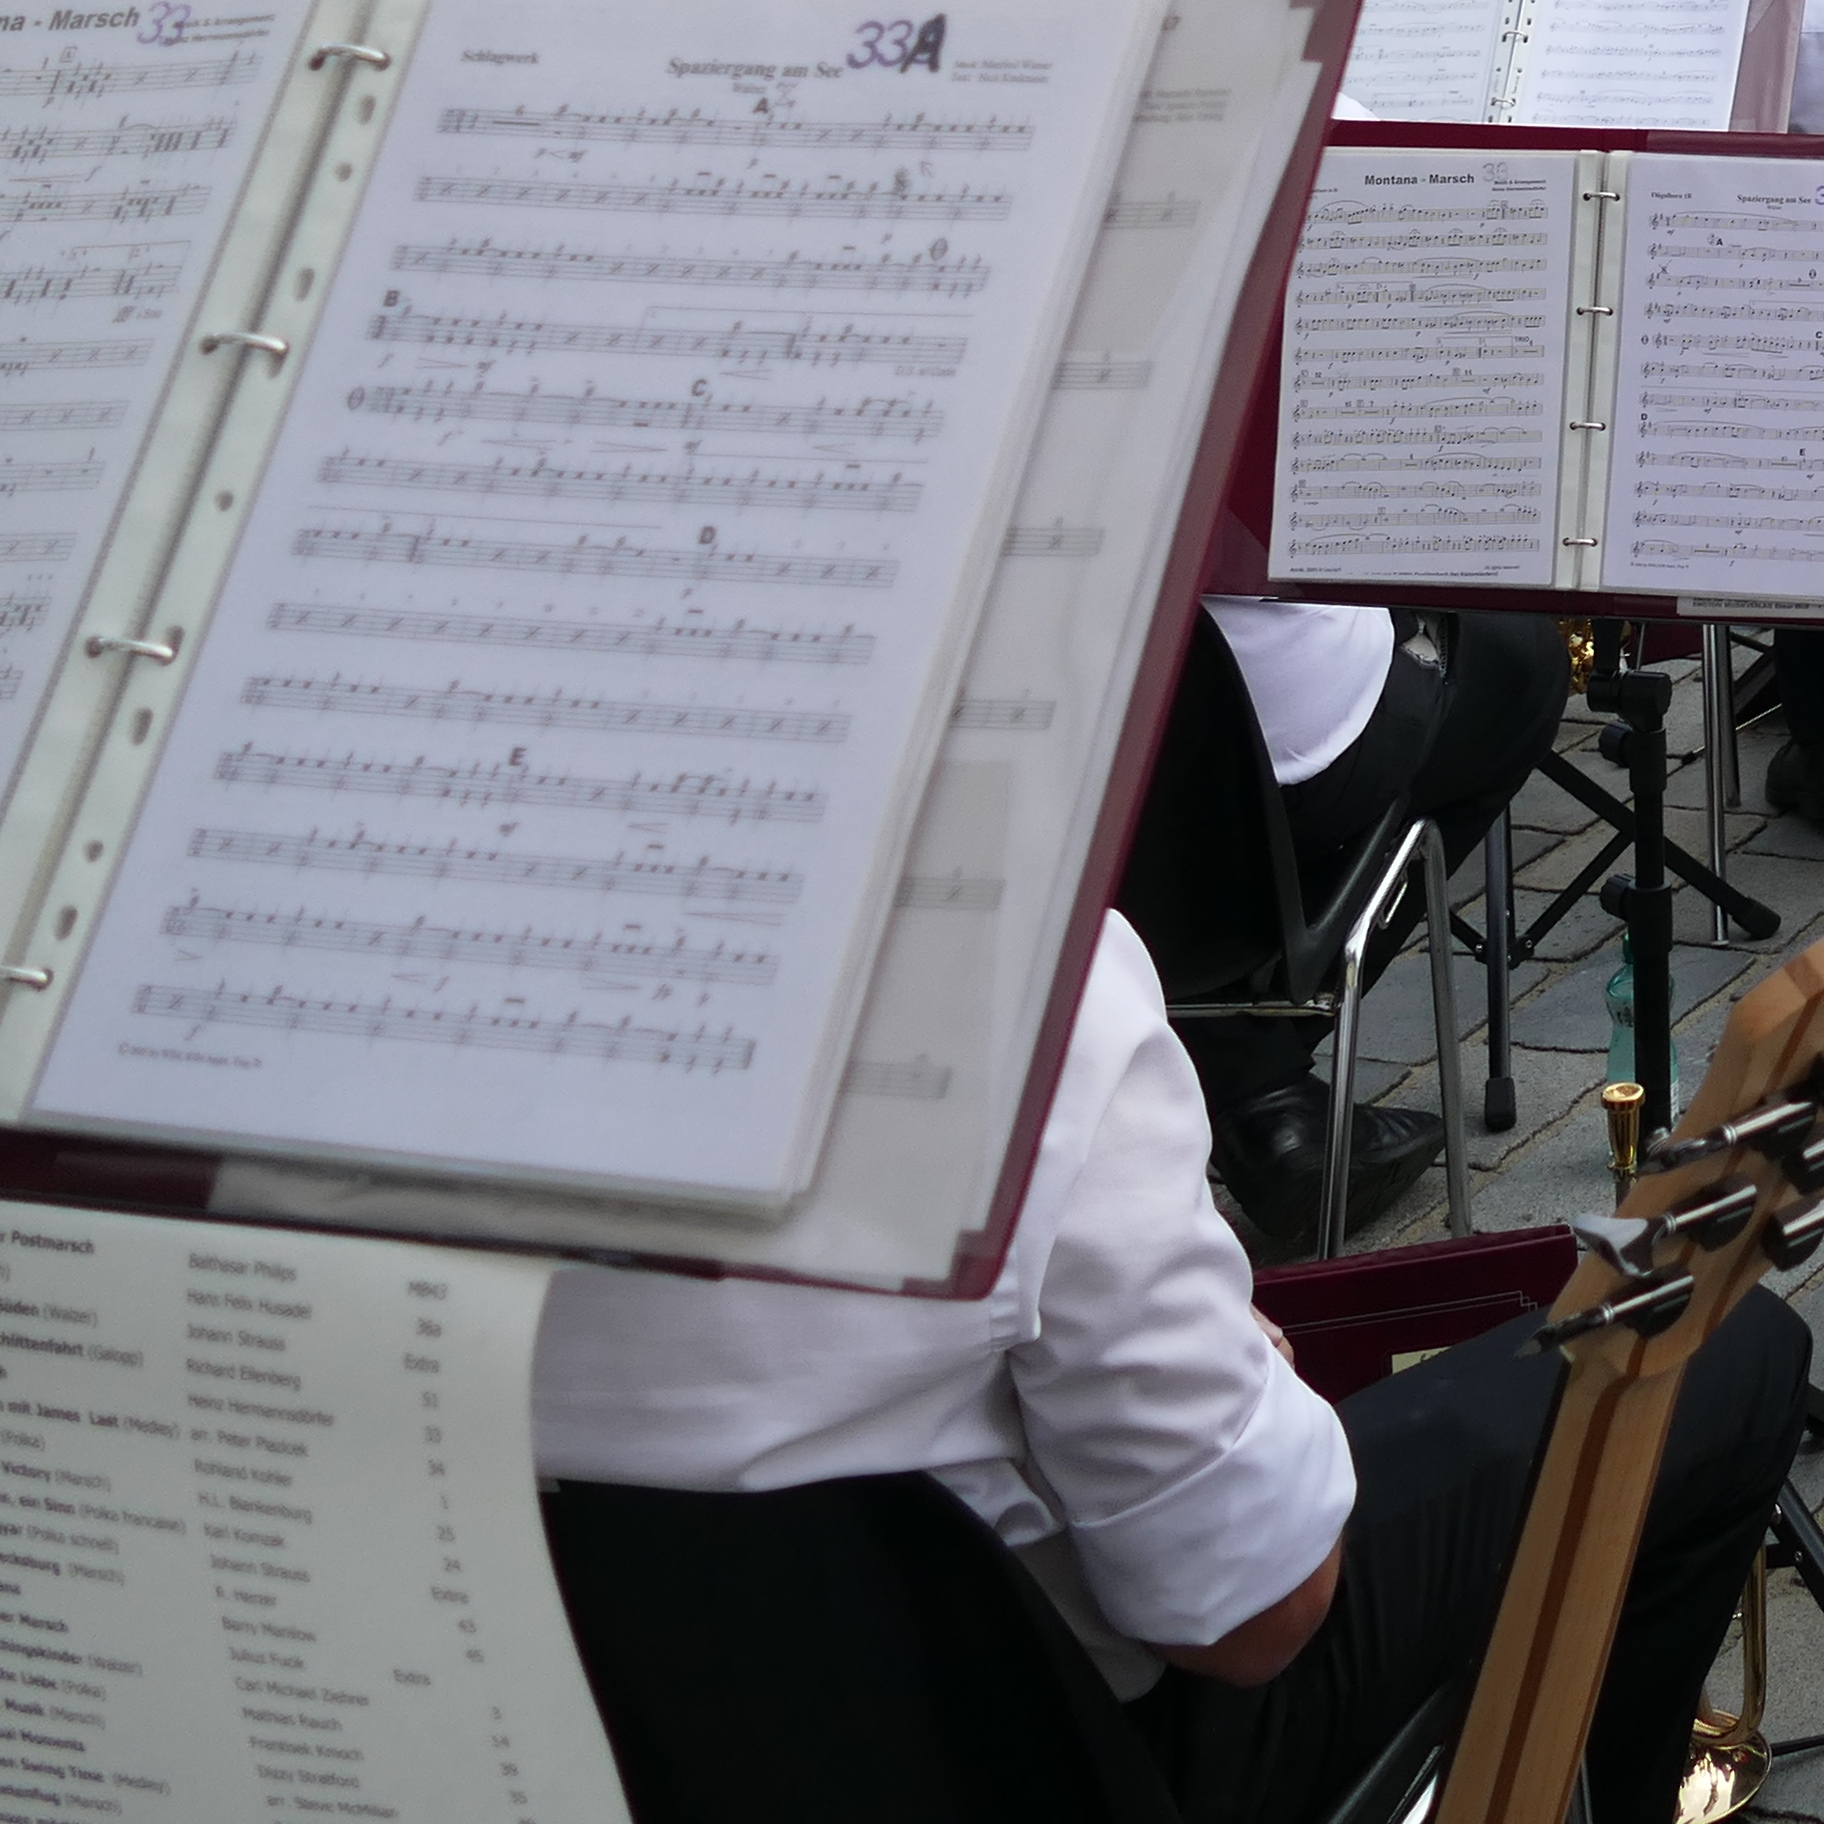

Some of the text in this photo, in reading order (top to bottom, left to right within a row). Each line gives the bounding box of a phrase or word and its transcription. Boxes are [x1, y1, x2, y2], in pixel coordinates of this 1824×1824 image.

[49, 6, 140, 31] Marsch
[137, 1, 191, 47] 33
[461, 48, 540, 66] Schlagwerk
[667, 57, 845, 79] Spaziergang am See
[1365, 173, 1475, 186] Montana Marsch
[1737, 194, 1784, 205] Spaziergang
[1799, 195, 1812, 204] See
[10, 1229, 95, 1256] Postmarsch
